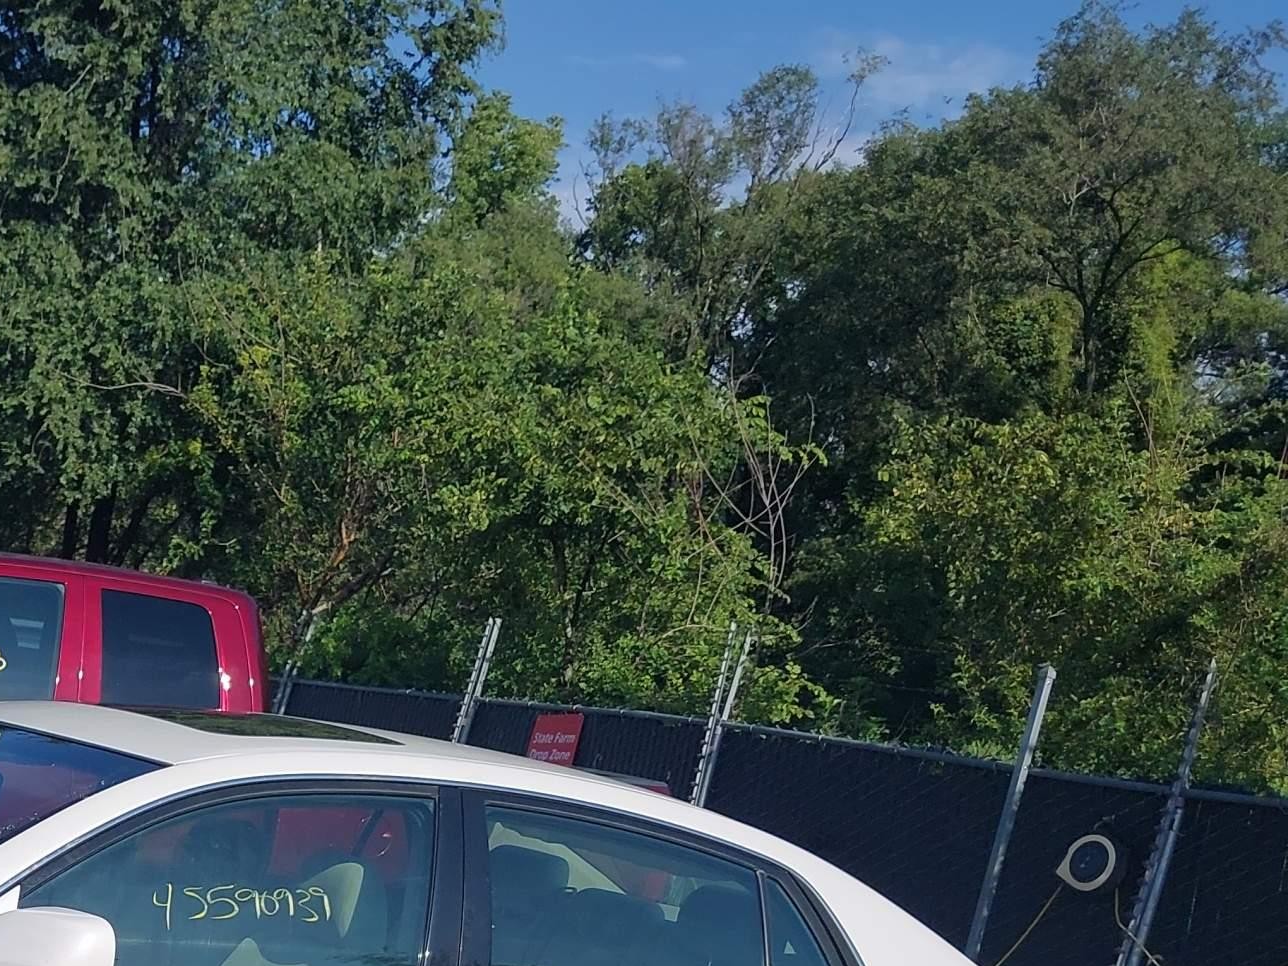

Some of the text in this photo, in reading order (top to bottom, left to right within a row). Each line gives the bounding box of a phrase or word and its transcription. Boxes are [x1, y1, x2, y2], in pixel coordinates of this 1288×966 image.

[533, 732, 576, 743] State Farm
[530, 749, 571, 760] Drop Zone
[152, 881, 332, 931] 45590939
